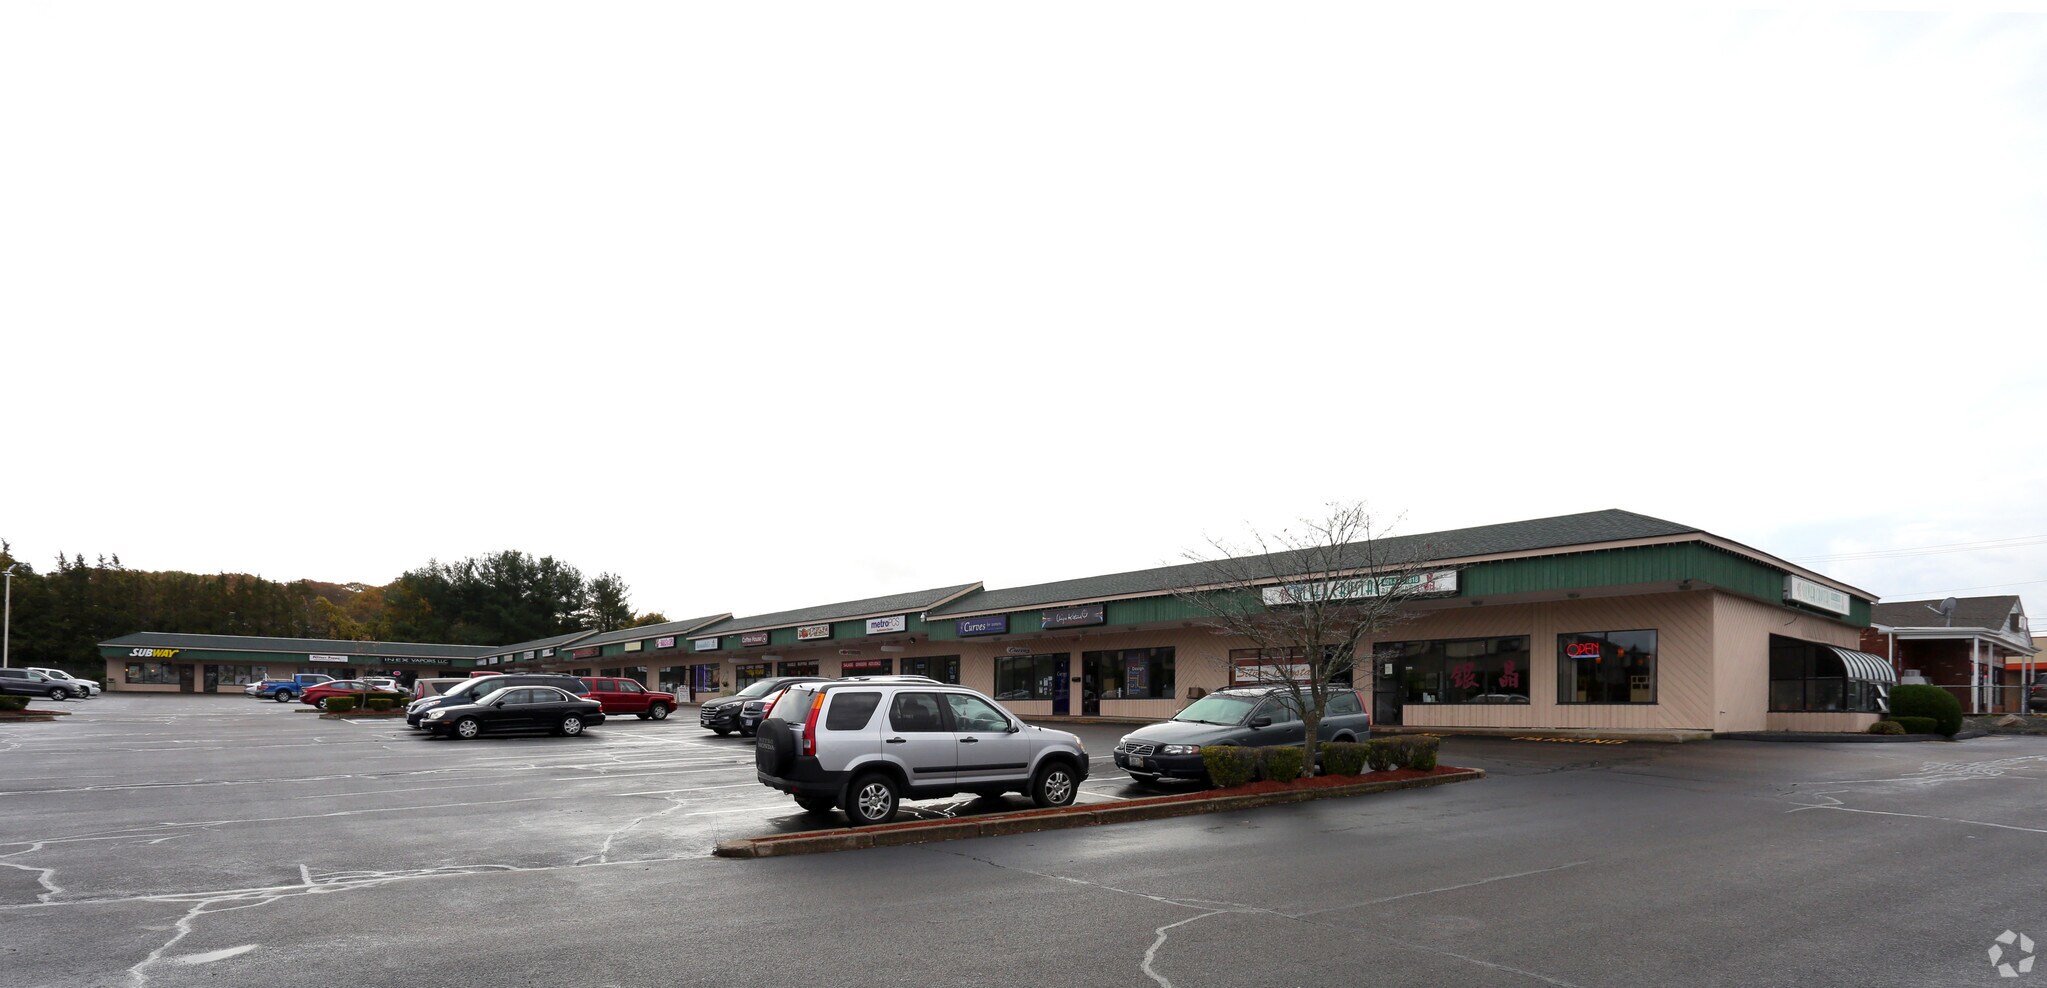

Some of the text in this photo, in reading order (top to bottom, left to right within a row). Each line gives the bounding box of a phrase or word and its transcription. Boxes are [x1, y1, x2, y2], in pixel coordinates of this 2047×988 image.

[963, 621, 986, 632] Curves
[128, 648, 180, 658] SUBWAY
[1567, 642, 1600, 657] OPEN
